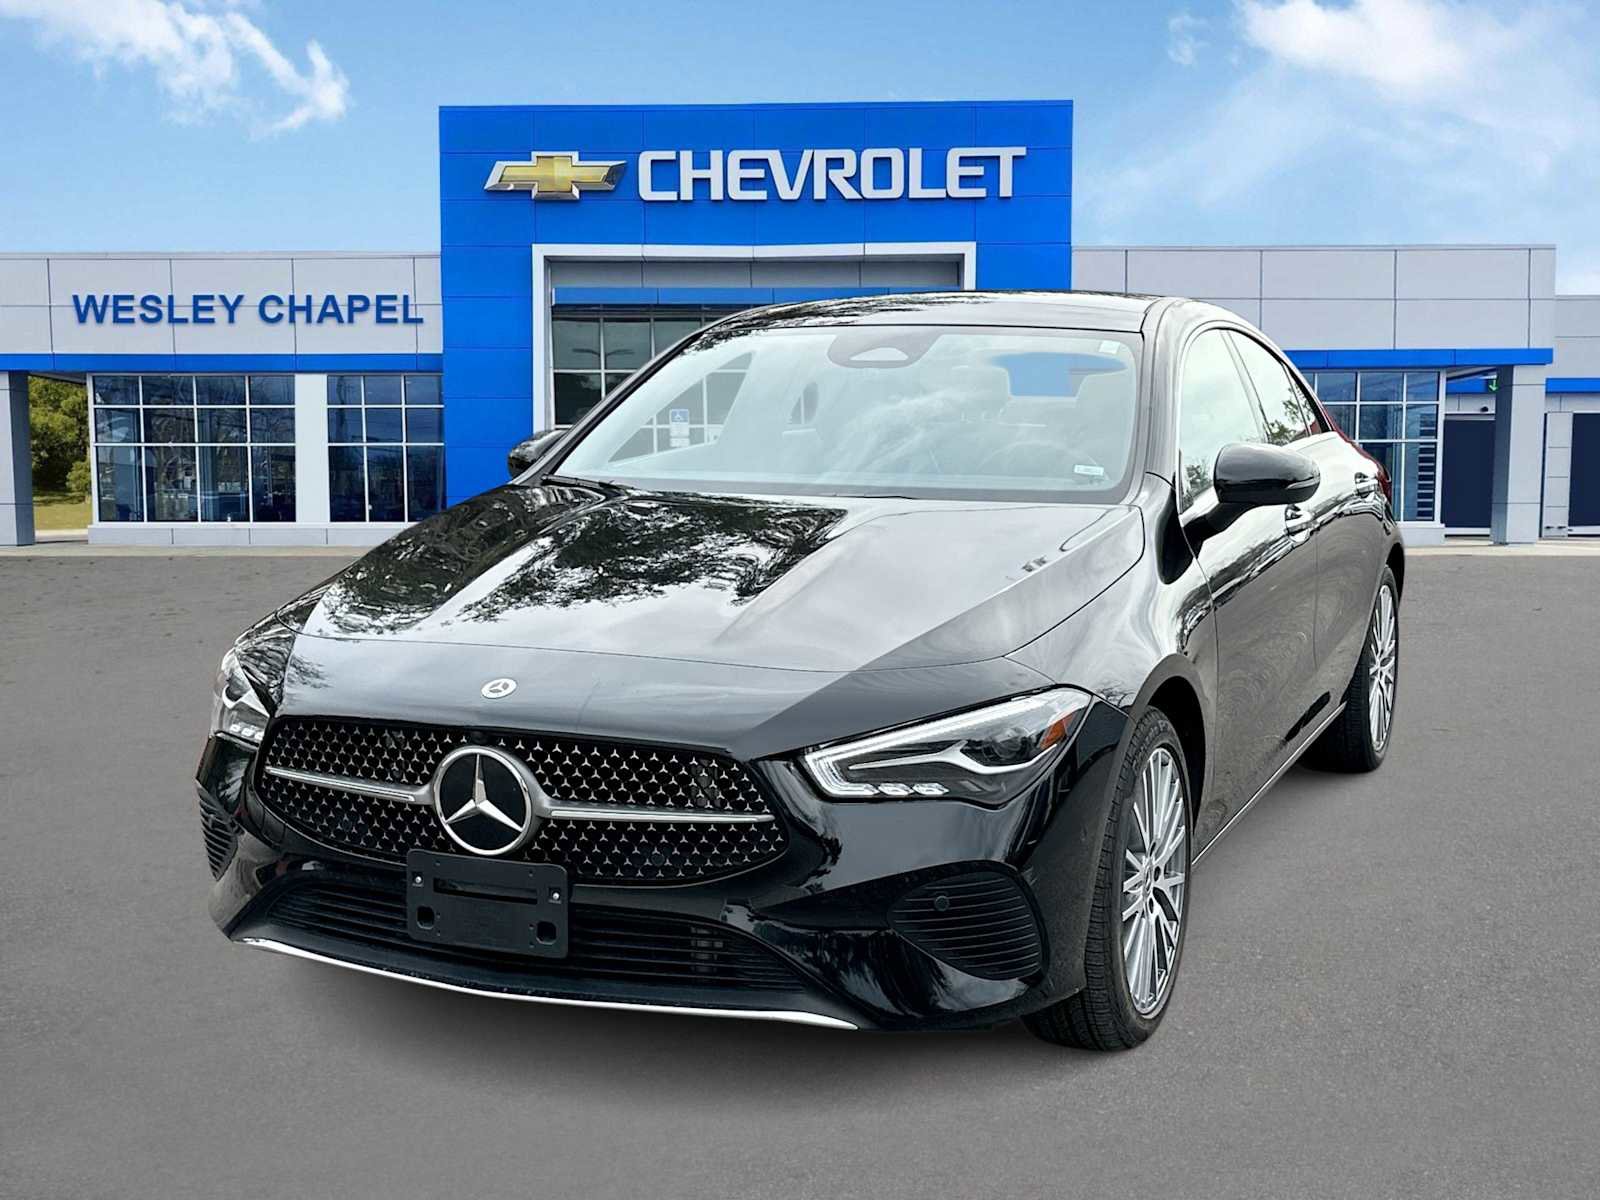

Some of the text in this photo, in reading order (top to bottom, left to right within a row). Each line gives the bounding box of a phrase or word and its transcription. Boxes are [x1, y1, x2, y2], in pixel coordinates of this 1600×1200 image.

[638, 146, 1027, 202] CHEVROLET
[72, 294, 424, 325] WESLEY CHAPEL
